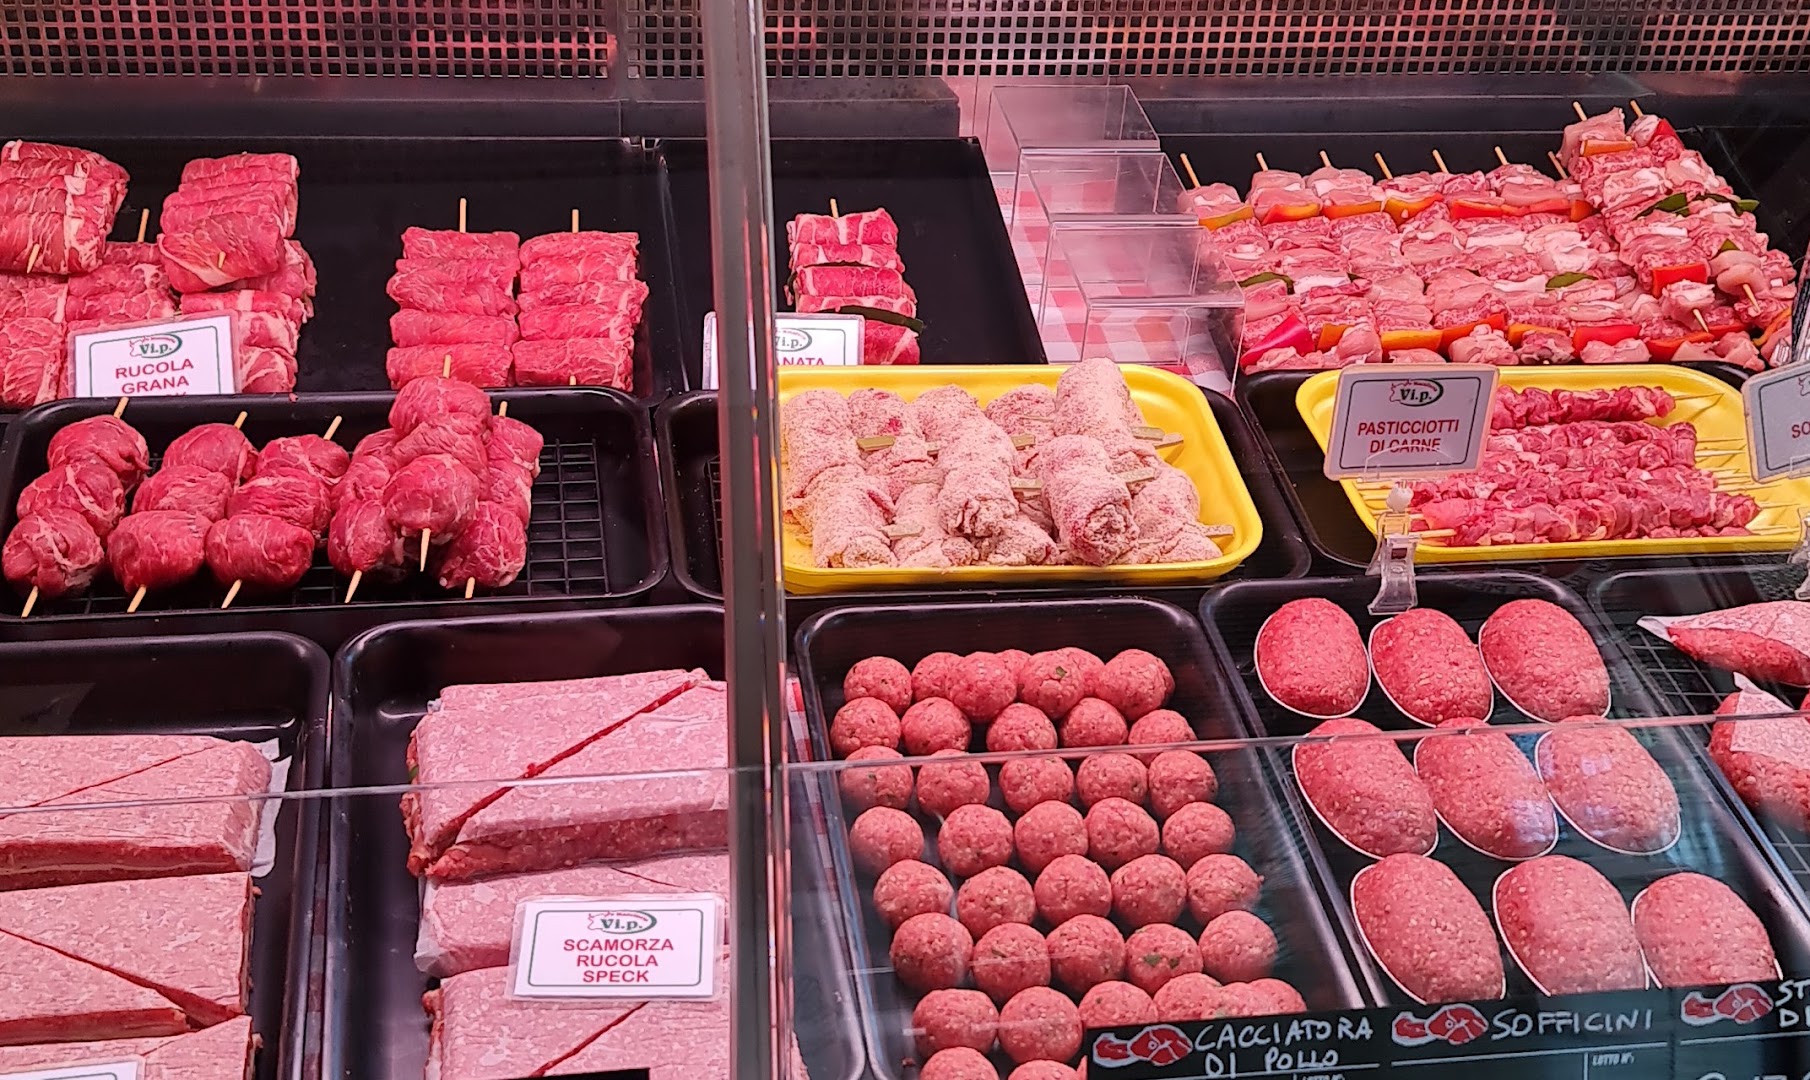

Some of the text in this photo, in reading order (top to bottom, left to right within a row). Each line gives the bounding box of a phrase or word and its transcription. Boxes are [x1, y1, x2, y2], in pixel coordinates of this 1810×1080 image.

[115, 358, 194, 379] RUCOLA
[121, 375, 190, 394] GRANA
[1357, 419, 1460, 436] PASTICCIOTTI
[1370, 438, 1441, 453] DI CARNE
[563, 938, 674, 951] SCAMORZA
[576, 954, 658, 967] RUCOLA
[582, 970, 649, 983] SPECK
[1195, 1016, 1374, 1051] CACCIATORA
[1491, 1009, 1652, 1040] SOFFICINI
[1264, 1046, 1339, 1072] POLLO
